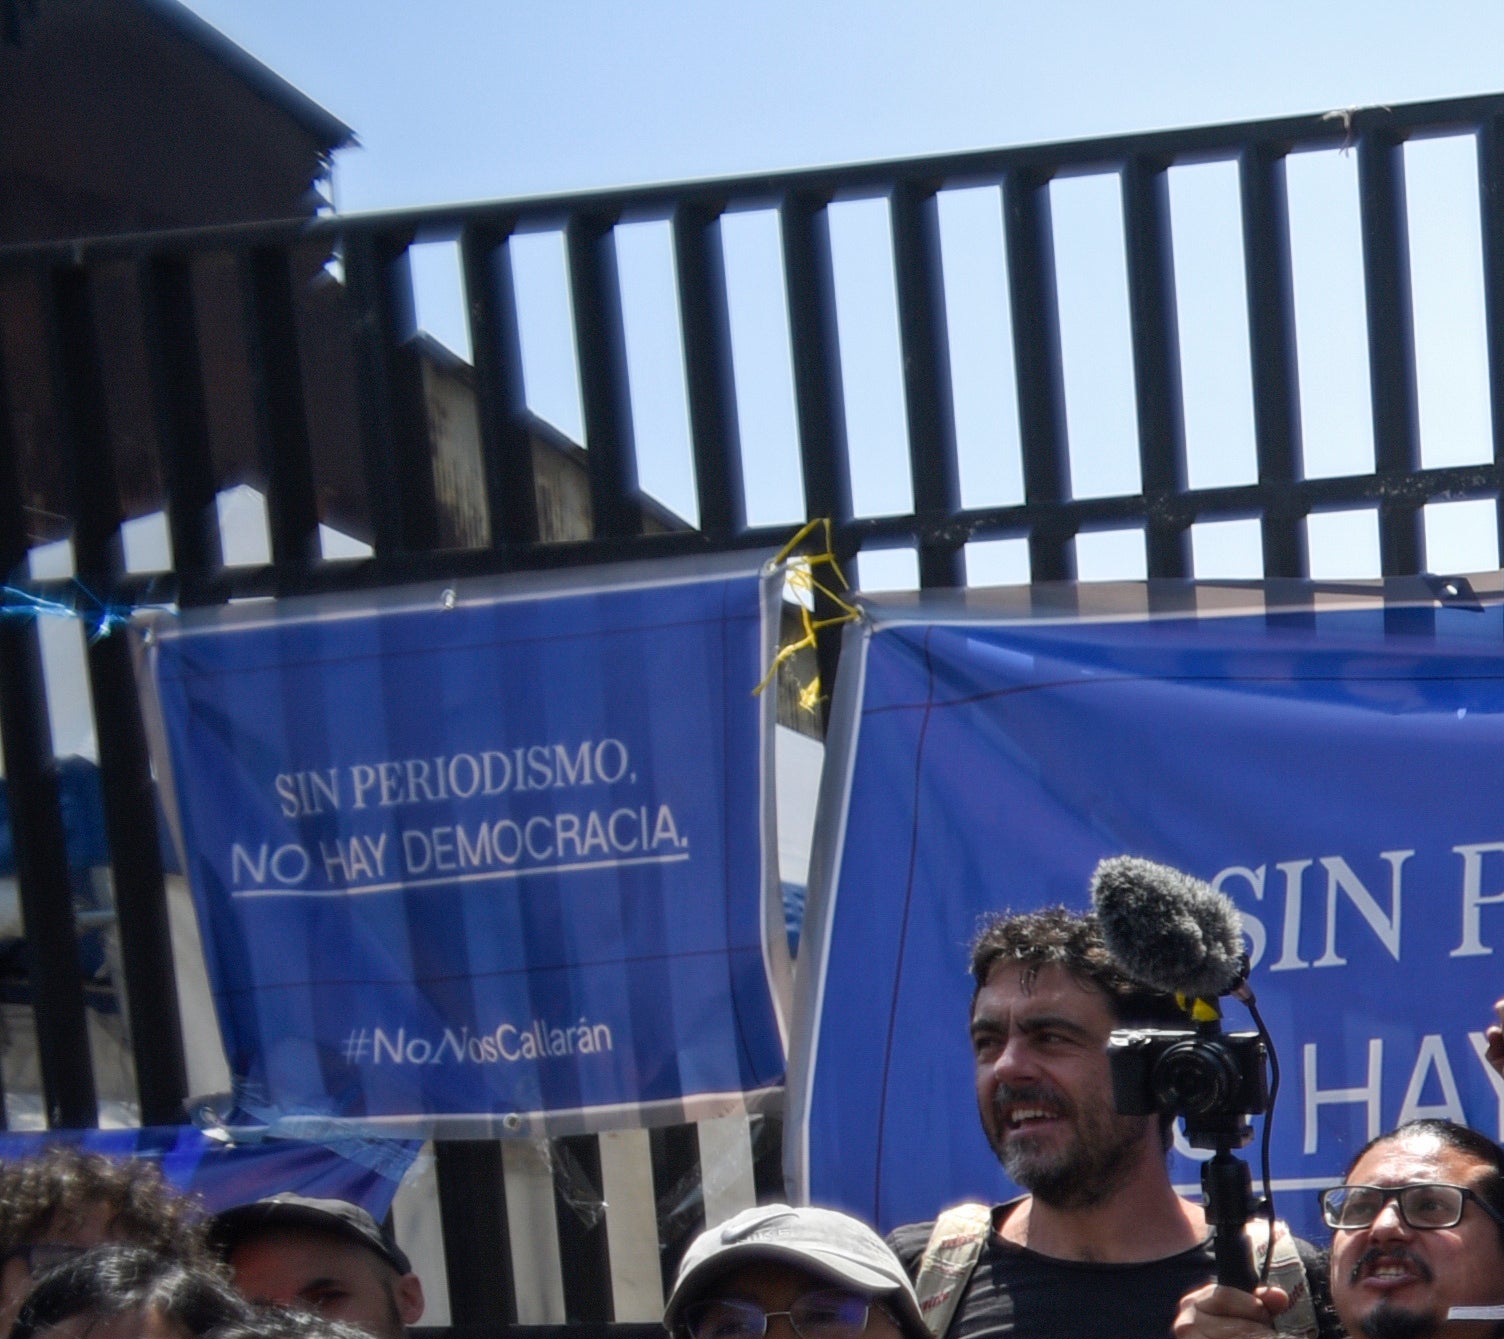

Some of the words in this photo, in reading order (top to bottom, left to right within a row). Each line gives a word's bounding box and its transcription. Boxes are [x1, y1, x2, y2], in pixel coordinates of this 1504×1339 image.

[274, 769, 341, 818] SIN
[352, 739, 638, 810] PERIODISMO,
[232, 843, 310, 883] NO
[320, 830, 389, 885] HAY
[404, 804, 690, 875] DEMOCRACIA.
[342, 1017, 613, 1067] #NoNosCallarán
